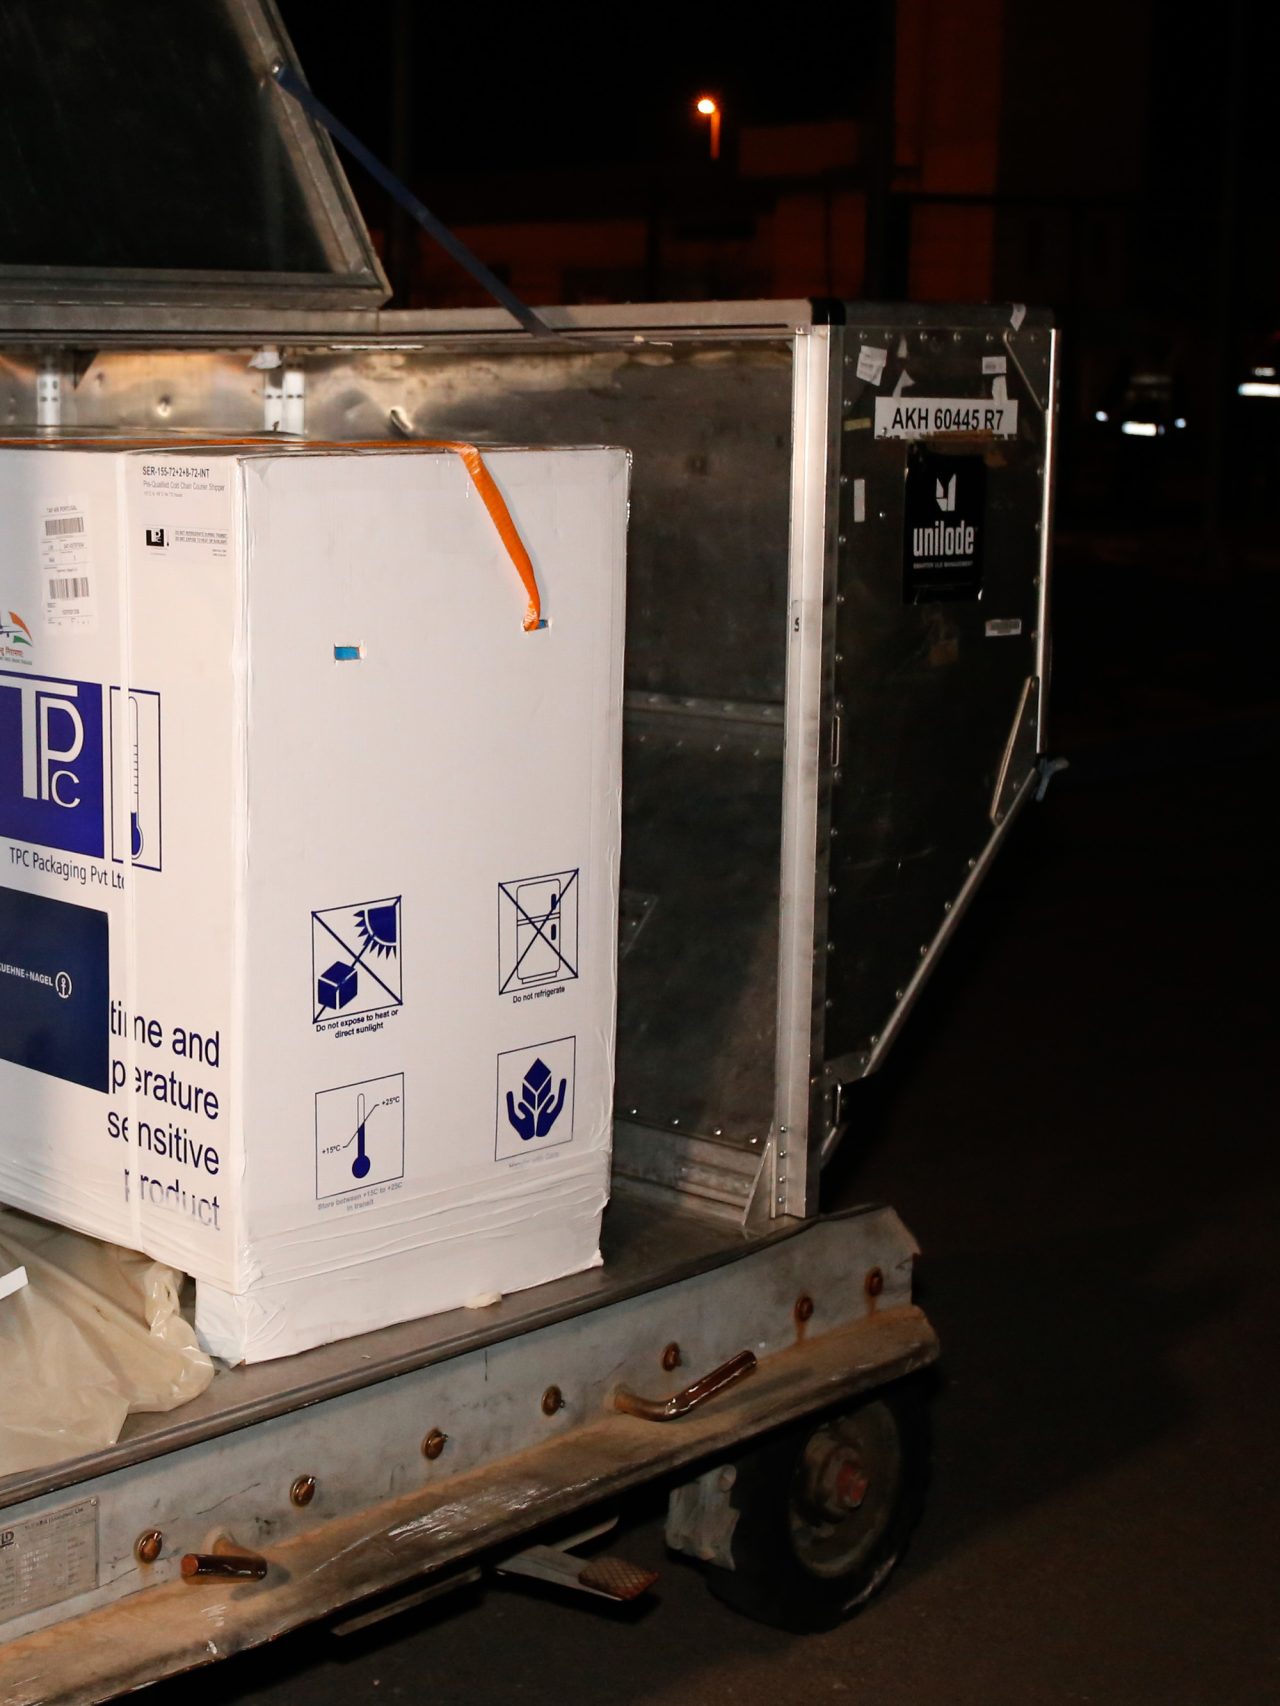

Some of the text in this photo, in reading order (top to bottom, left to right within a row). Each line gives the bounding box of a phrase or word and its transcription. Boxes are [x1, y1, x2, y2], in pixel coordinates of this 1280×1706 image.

[892, 408, 1004, 431] AKH 60445 R7
[913, 520, 975, 557] unilode
[10, 846, 31, 868] TPC
[33, 852, 87, 886] Packaging
[90, 865, 109, 887] Pvt
[513, 986, 566, 1004] Do not refrigerate
[316, 1024, 326, 1033] Do
[327, 1021, 339, 1030] not
[340, 1016, 365, 1027] expose
[375, 1010, 390, 1019] heat
[335, 1022, 384, 1039] direct sunlight
[171, 1031, 220, 1068] and
